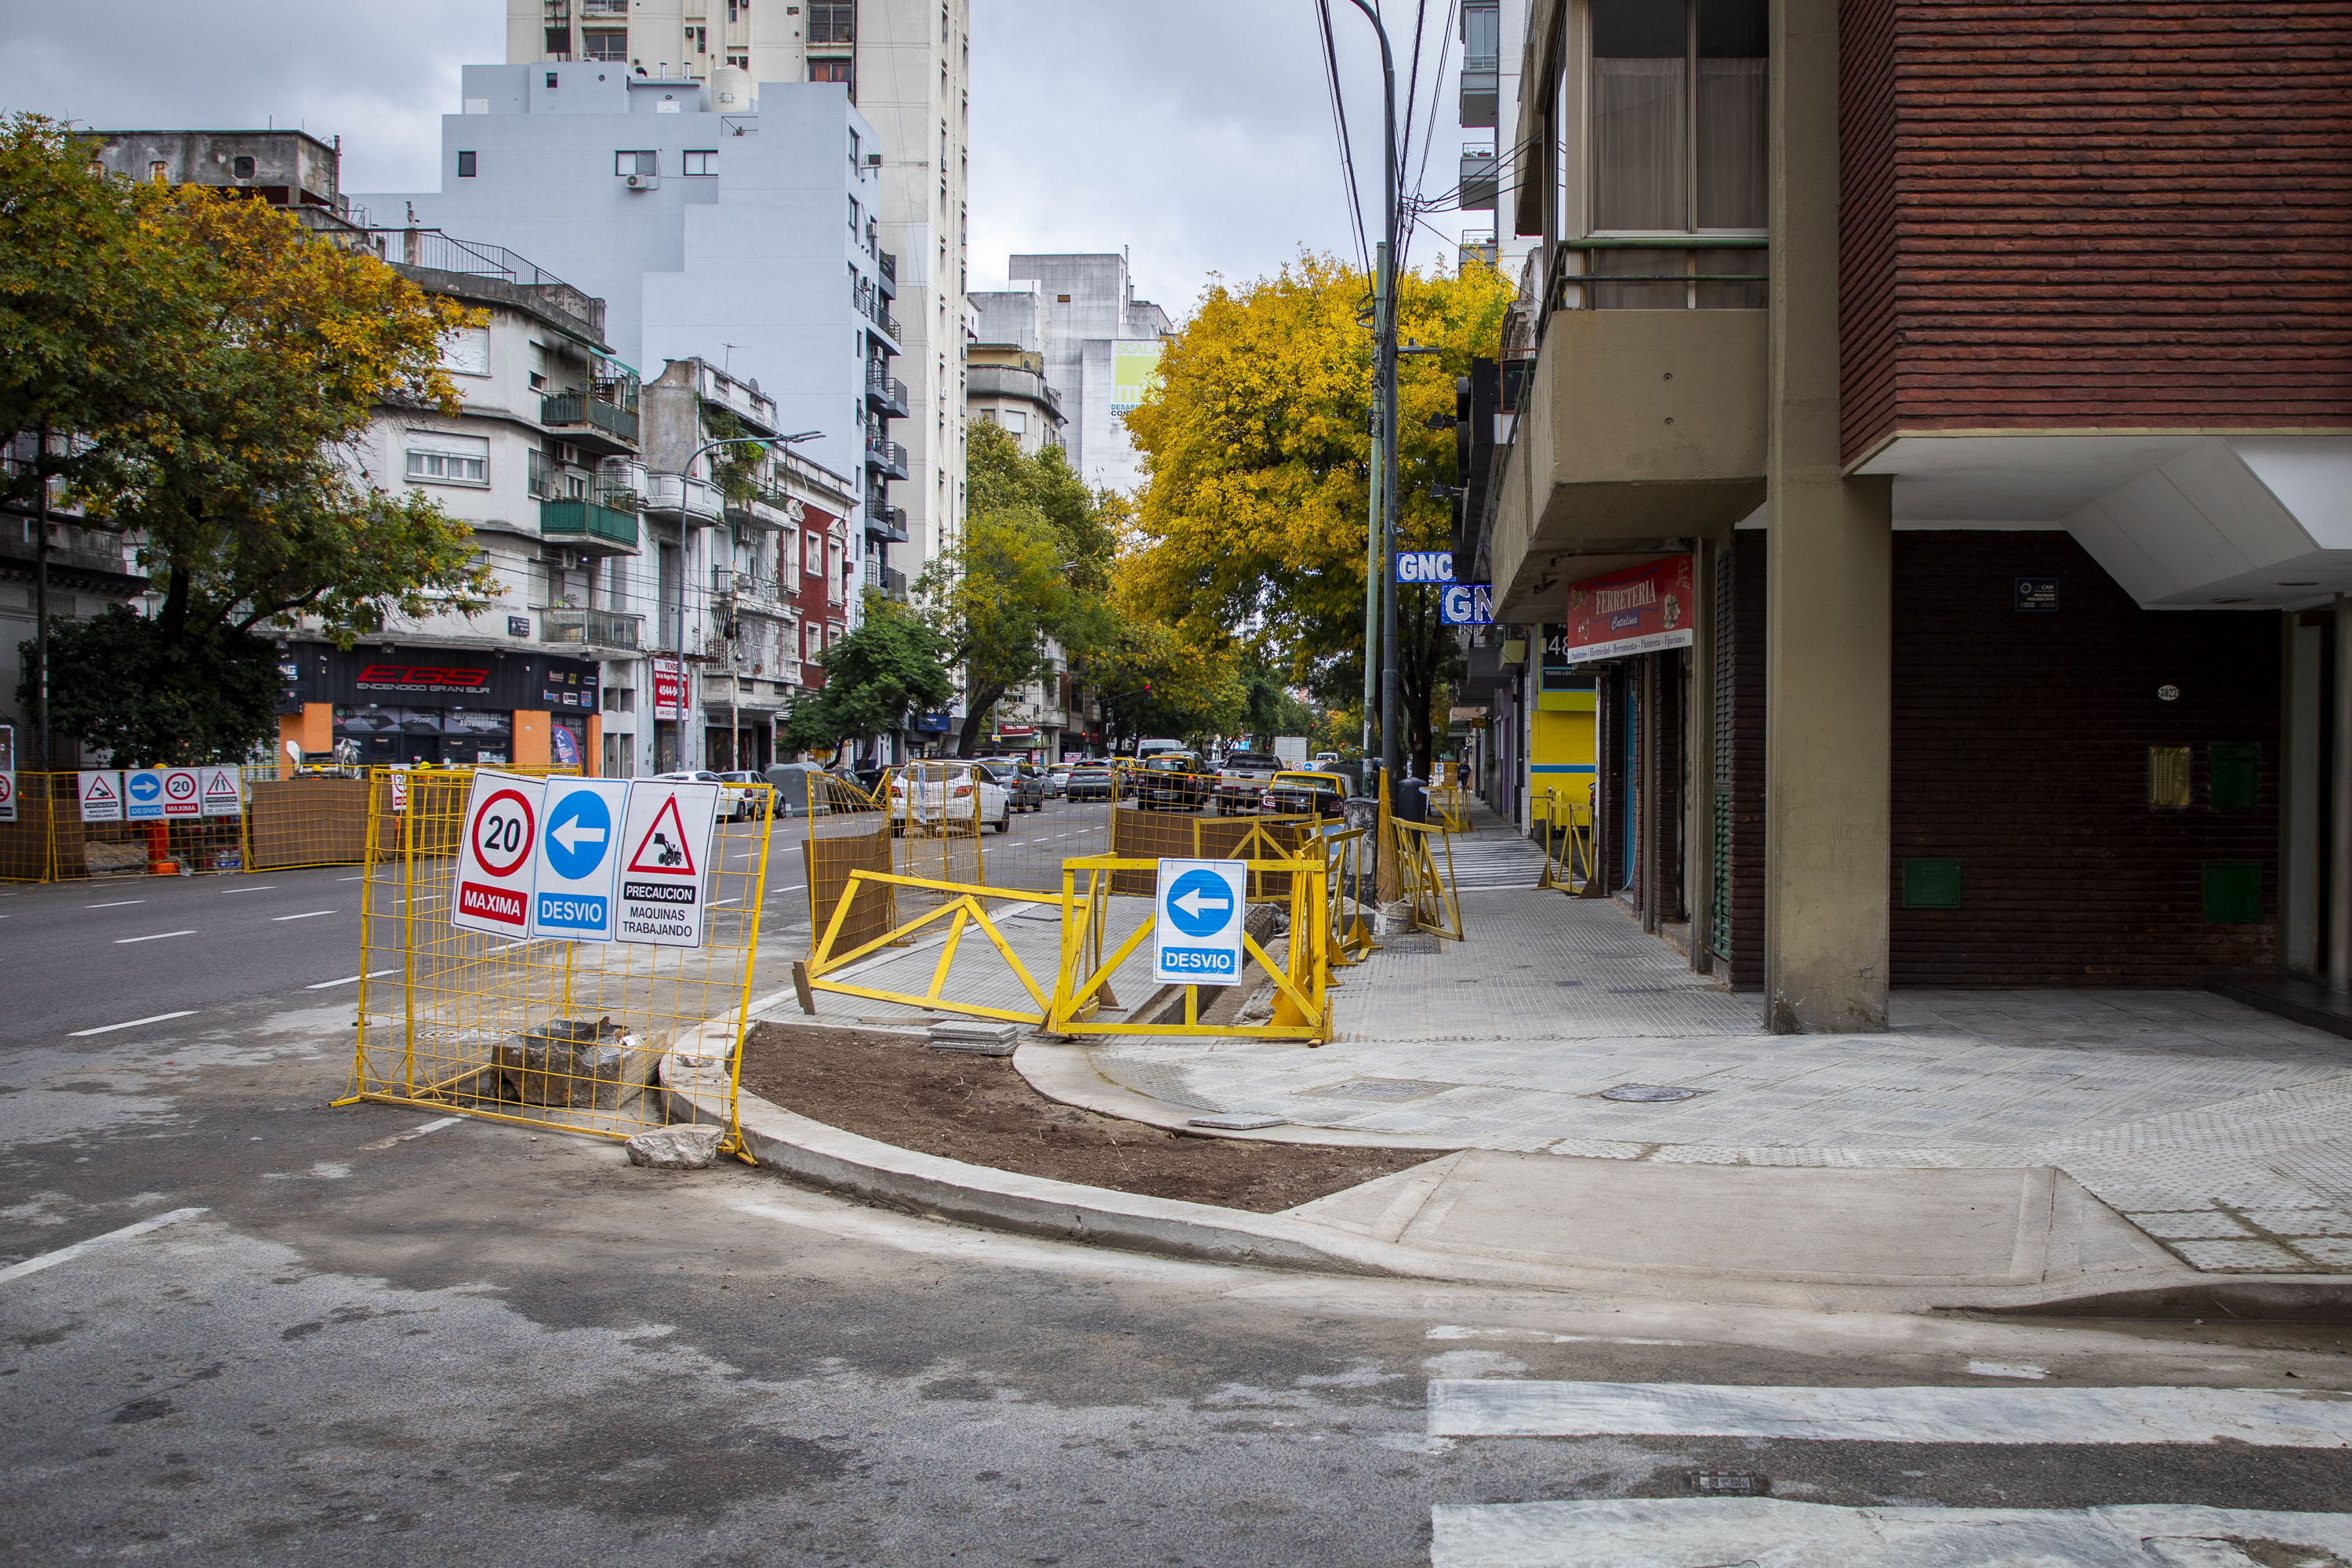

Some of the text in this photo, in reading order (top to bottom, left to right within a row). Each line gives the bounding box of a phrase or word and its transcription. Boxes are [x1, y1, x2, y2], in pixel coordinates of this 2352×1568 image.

[1399, 554, 1453, 580] GNC
[1595, 578, 1657, 615] FERRETERIA
[1611, 615, 1637, 630] Catalina
[1571, 634, 1686, 659] Sanitarios Electricidad Herramientas Pintureria Fijaciones
[357, 665, 490, 686] EGS
[357, 683, 427, 691] ENCENDIDO
[172, 781, 190, 793] 20
[484, 815, 521, 853] 20
[626, 884, 692, 901] PRECAUCION
[464, 890, 521, 916] MAXIMA
[542, 900, 602, 923] DESVIO
[630, 906, 685, 921] MAQUINAS
[622, 920, 692, 938] TRABAJANDO
[1166, 952, 1230, 969] DESVIO
